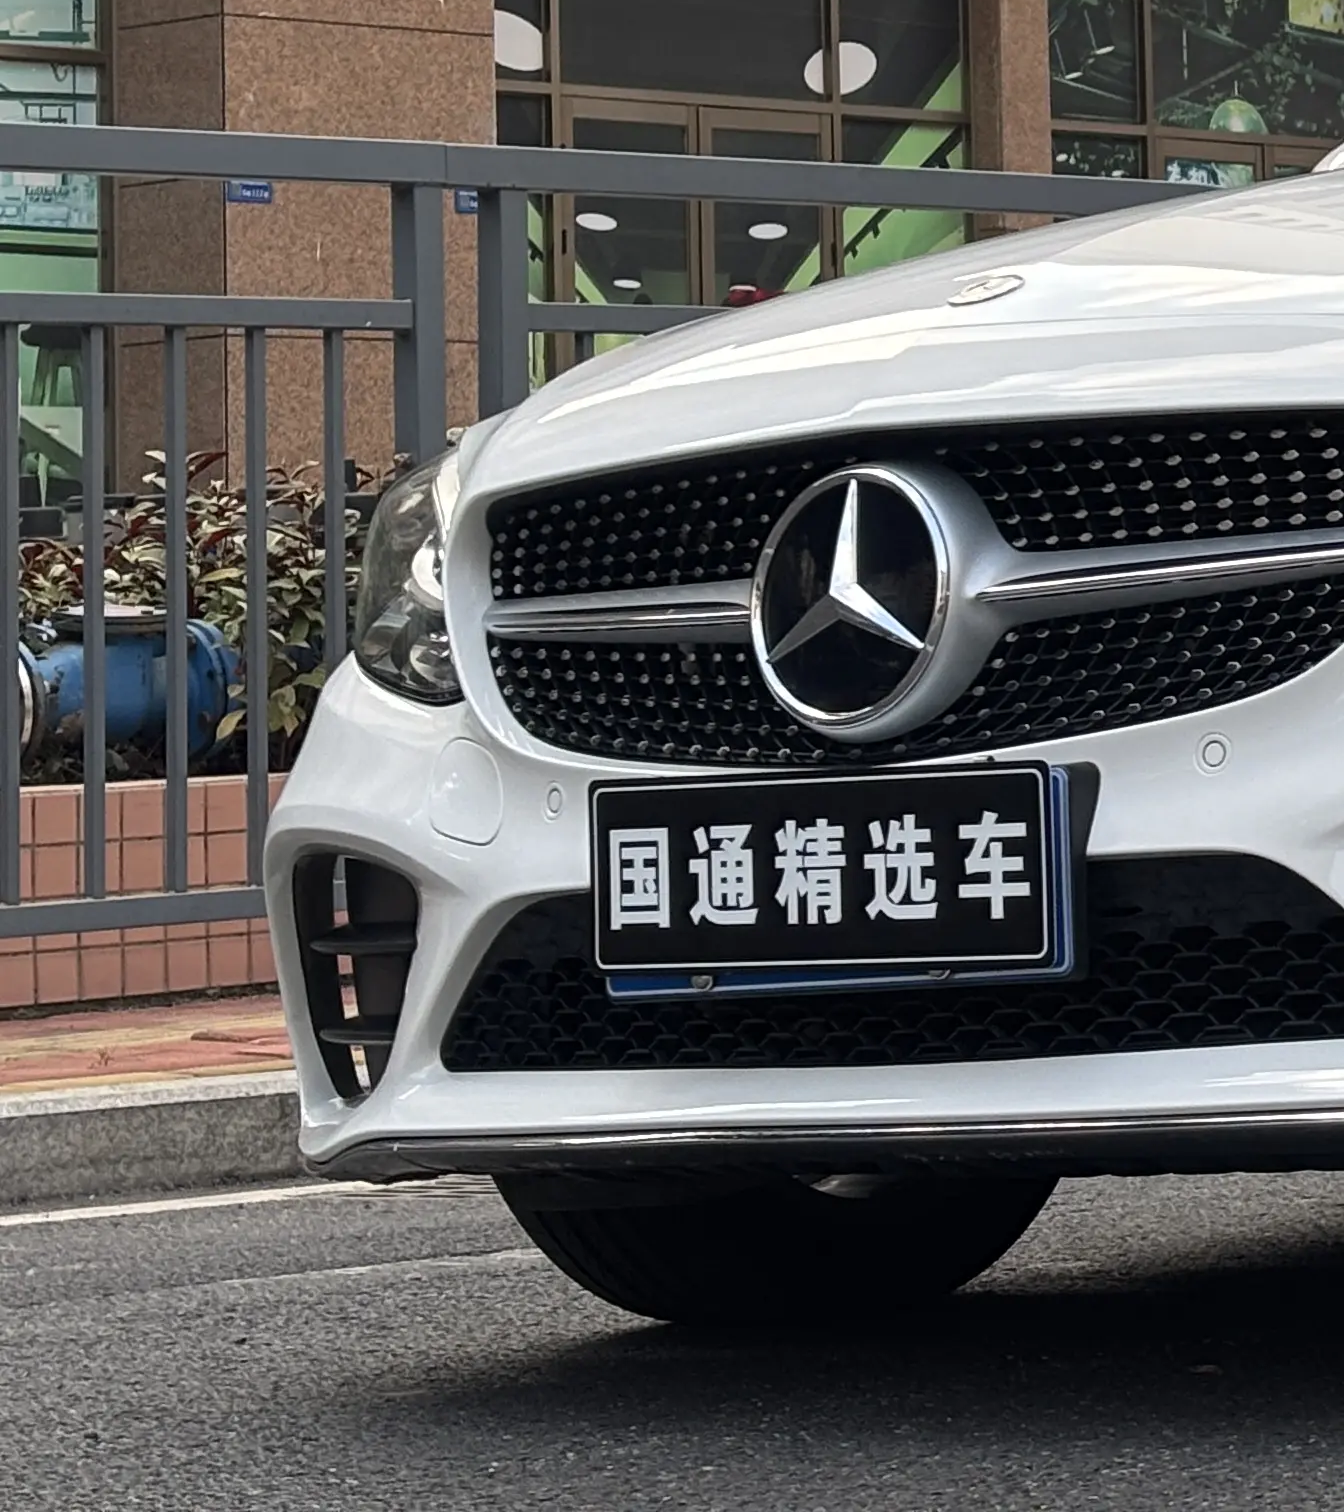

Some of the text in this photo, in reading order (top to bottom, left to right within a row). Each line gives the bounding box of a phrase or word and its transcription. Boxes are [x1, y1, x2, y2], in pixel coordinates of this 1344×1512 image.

[608, 811, 1032, 931] 国通精选车
